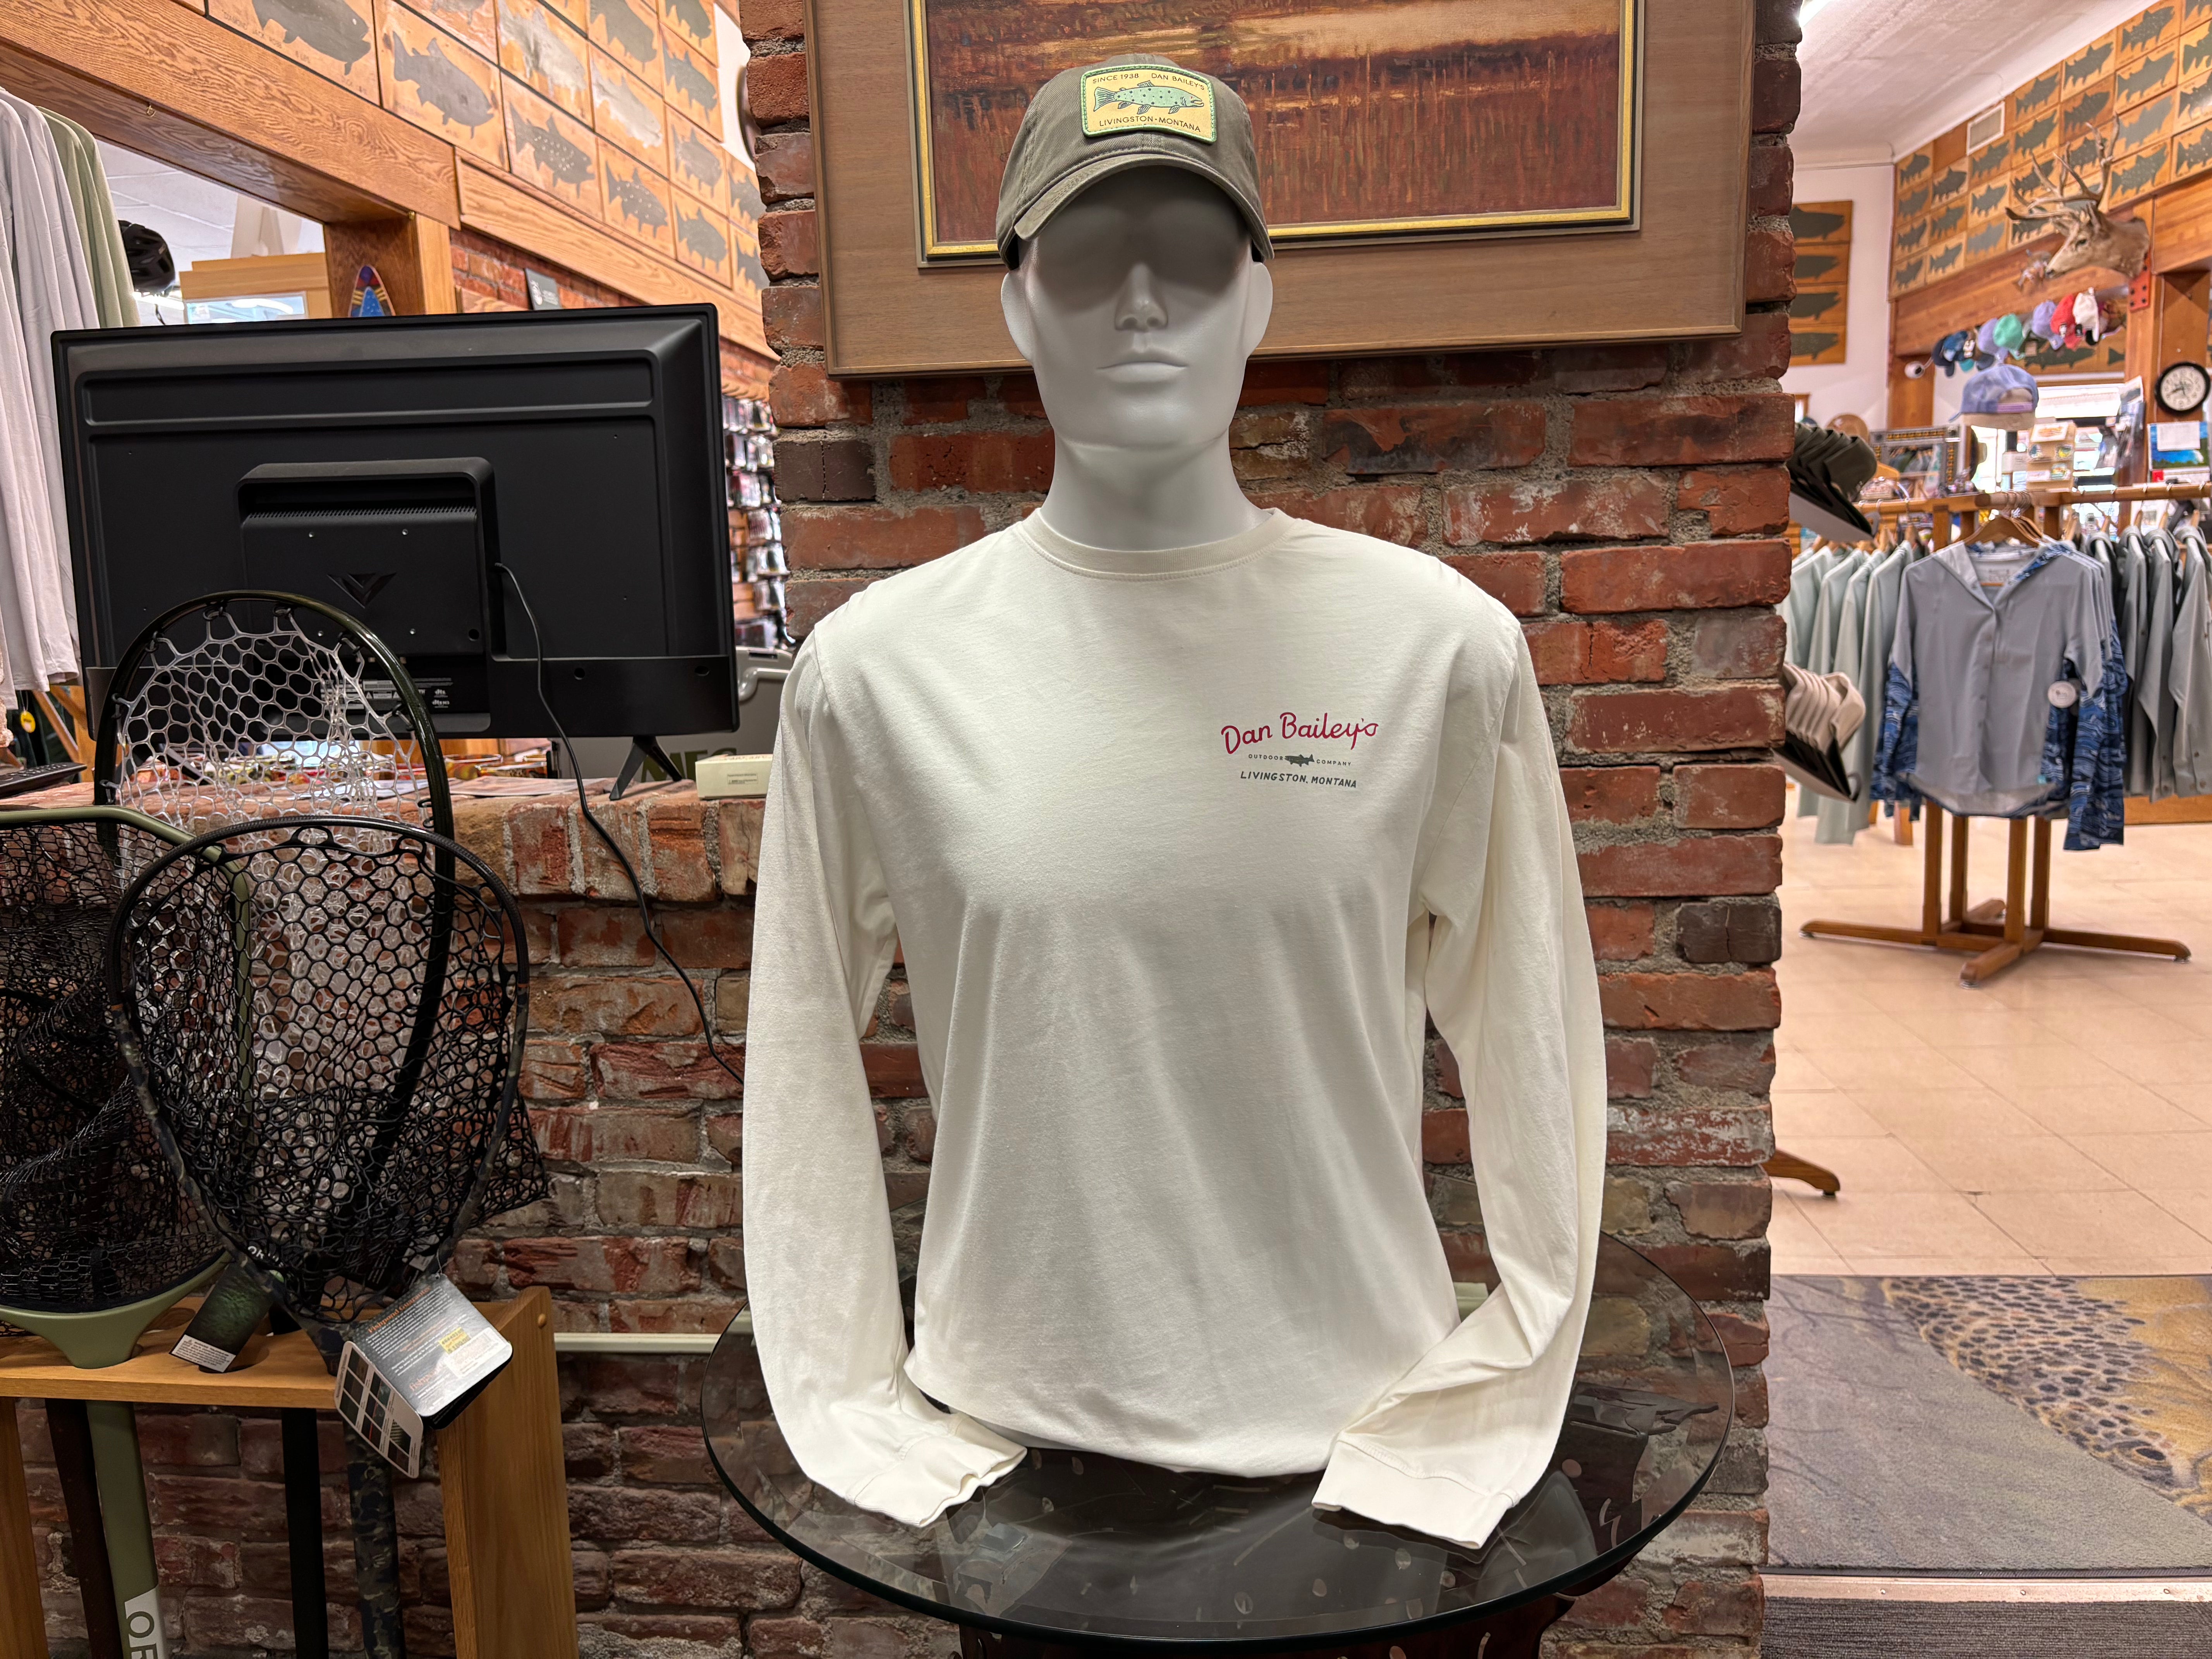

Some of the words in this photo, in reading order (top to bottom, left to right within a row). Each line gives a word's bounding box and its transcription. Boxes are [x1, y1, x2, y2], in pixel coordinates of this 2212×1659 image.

[1092, 75, 1118, 84] SINCE
[1172, 76, 1204, 90] BAILEY'S
[1221, 725, 1273, 754] Dan
[1279, 712, 1379, 750] Bailey's
[1312, 776, 1357, 788] MONTANA
